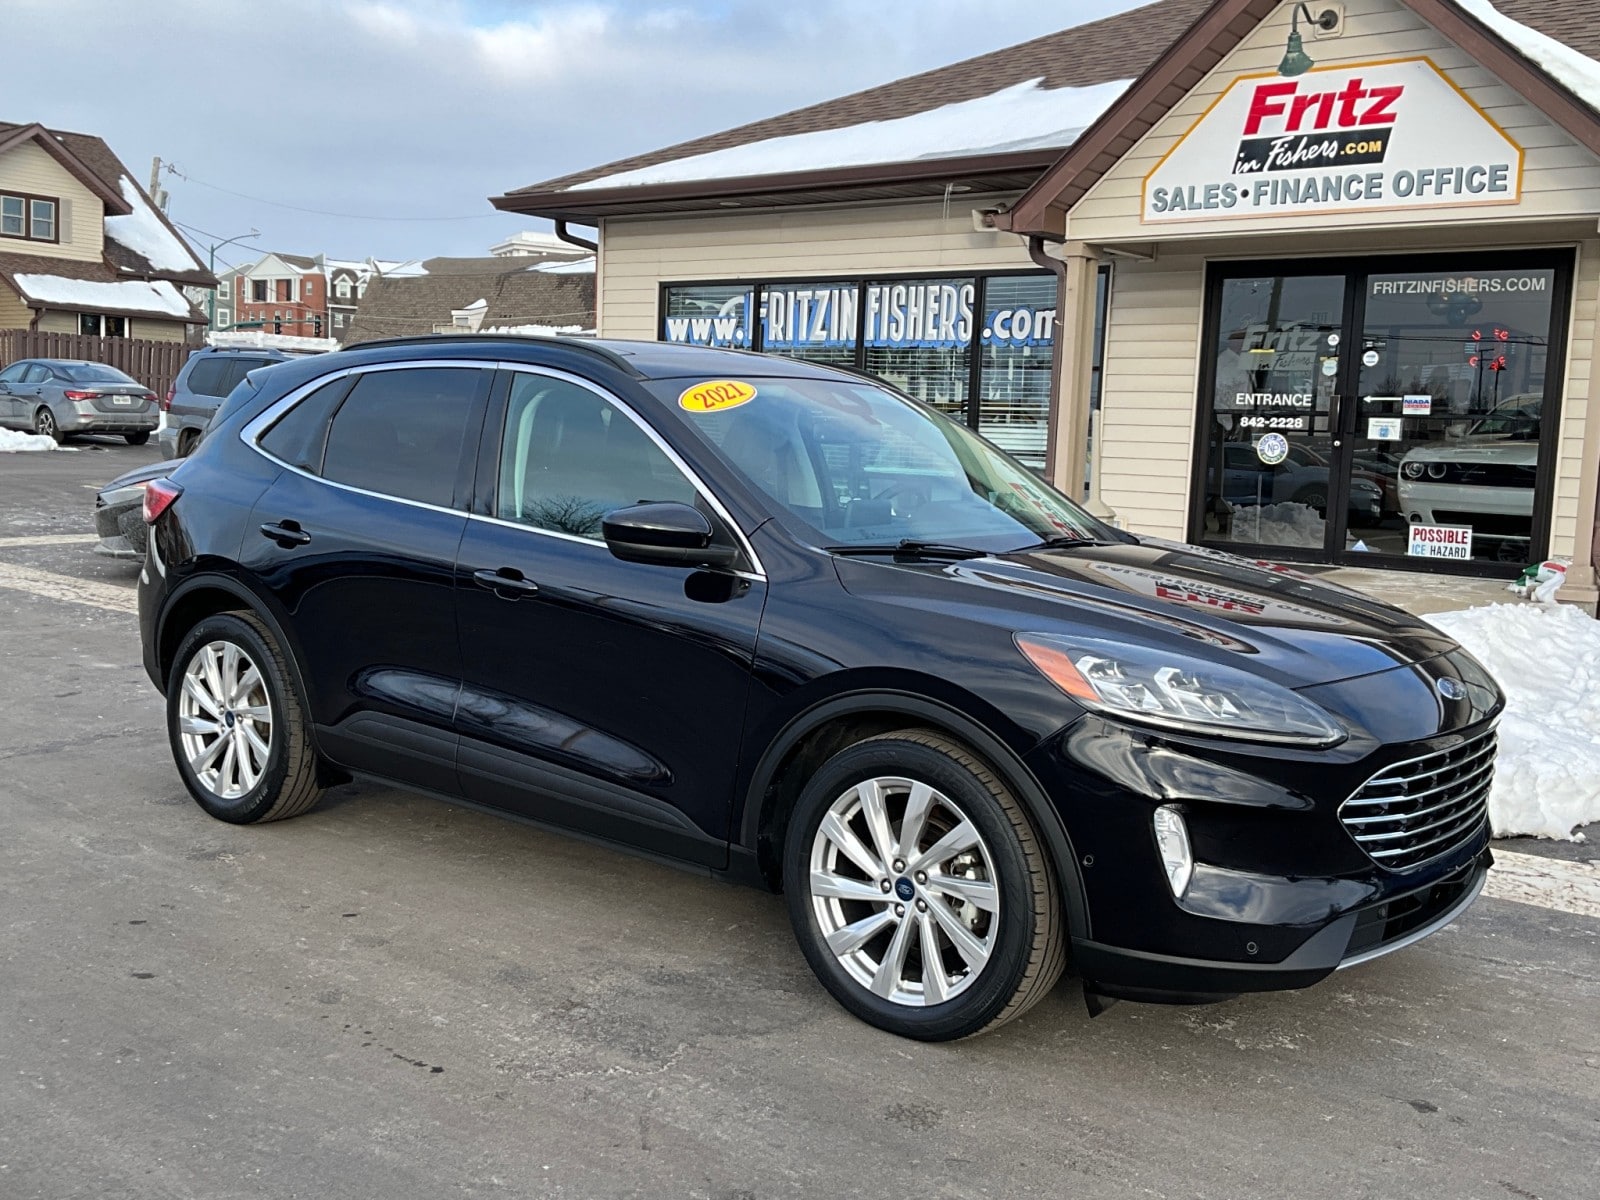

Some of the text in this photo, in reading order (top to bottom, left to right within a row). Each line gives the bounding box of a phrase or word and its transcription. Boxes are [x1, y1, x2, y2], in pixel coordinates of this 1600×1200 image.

[1243, 78, 1404, 136] Fritz
[1235, 153, 1261, 174] in
[1392, 164, 1509, 198] OFFICE
[1373, 277, 1546, 295] FRITZINFISHERS.COM
[1241, 321, 1321, 352] Fritz
[693, 383, 747, 409] 2021
[1235, 393, 1312, 406] ENTRANCE
[1240, 416, 1304, 428] 842-2228
[1413, 528, 1469, 545] POSSIBLE
[1411, 543, 1467, 558] ICE HAZARD
